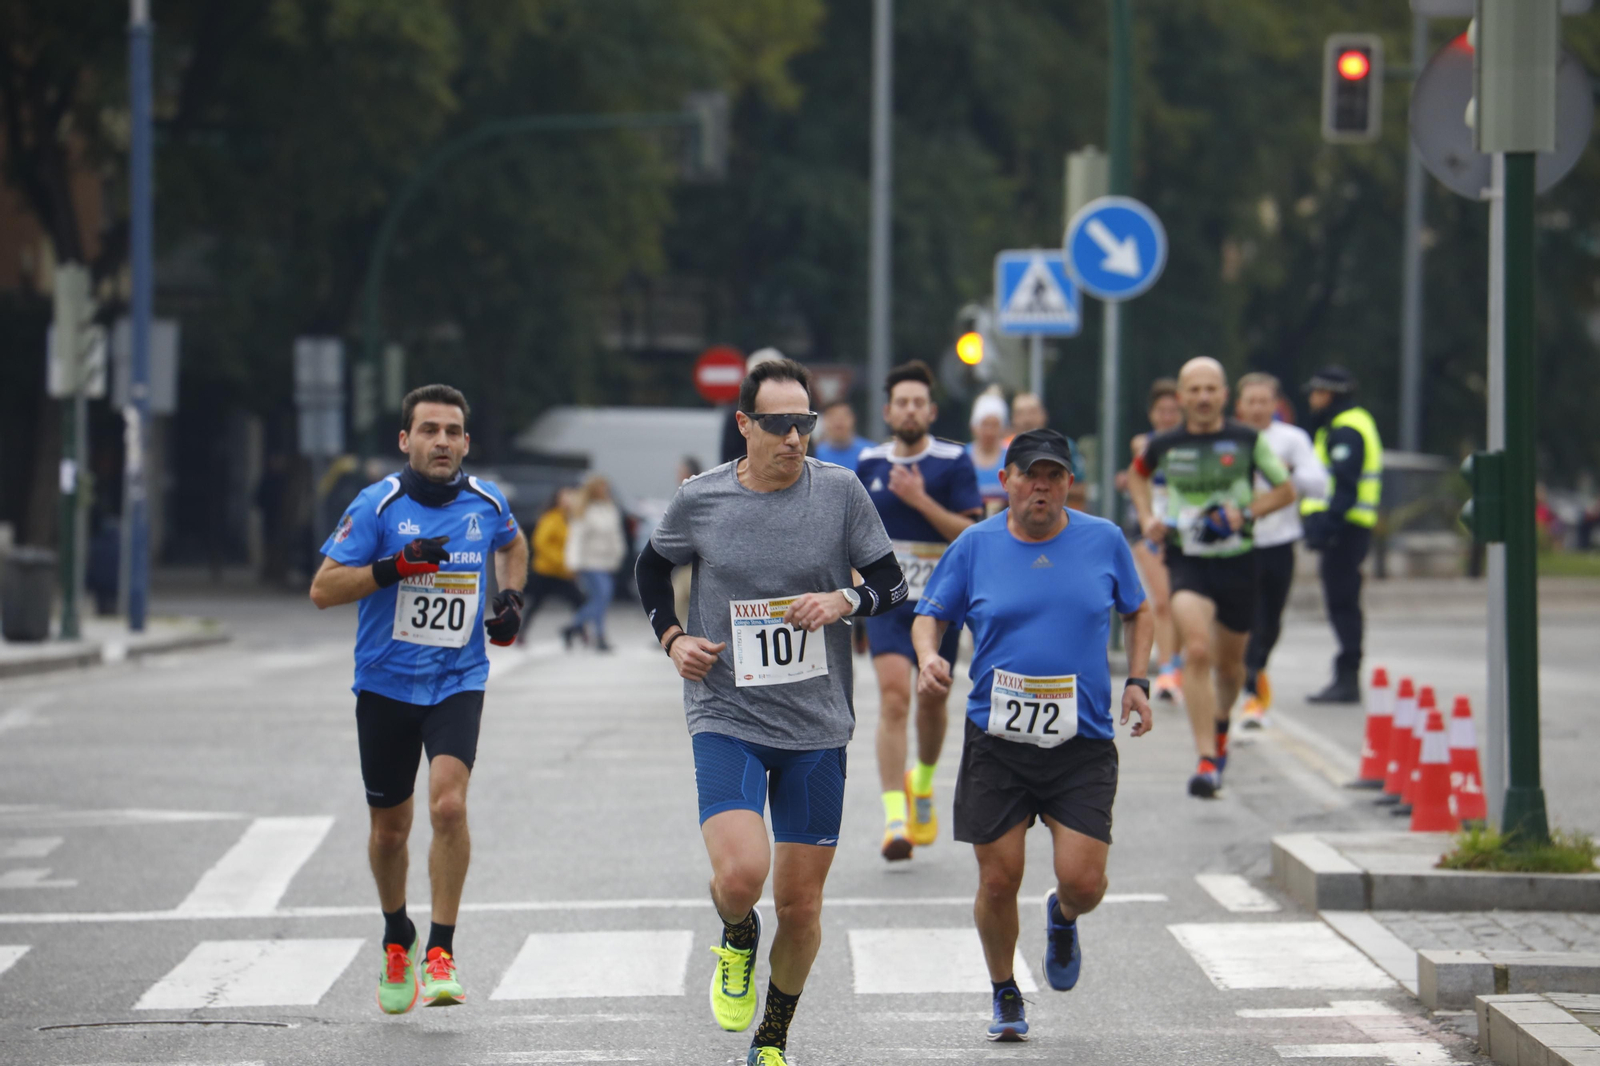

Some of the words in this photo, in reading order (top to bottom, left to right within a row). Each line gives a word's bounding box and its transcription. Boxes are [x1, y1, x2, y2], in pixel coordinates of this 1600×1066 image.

[411, 596, 466, 631] 320
[734, 603, 770, 618] XXXIX
[756, 627, 808, 667] 107
[997, 673, 1024, 691] XXXIX
[1005, 700, 1059, 735] 272
